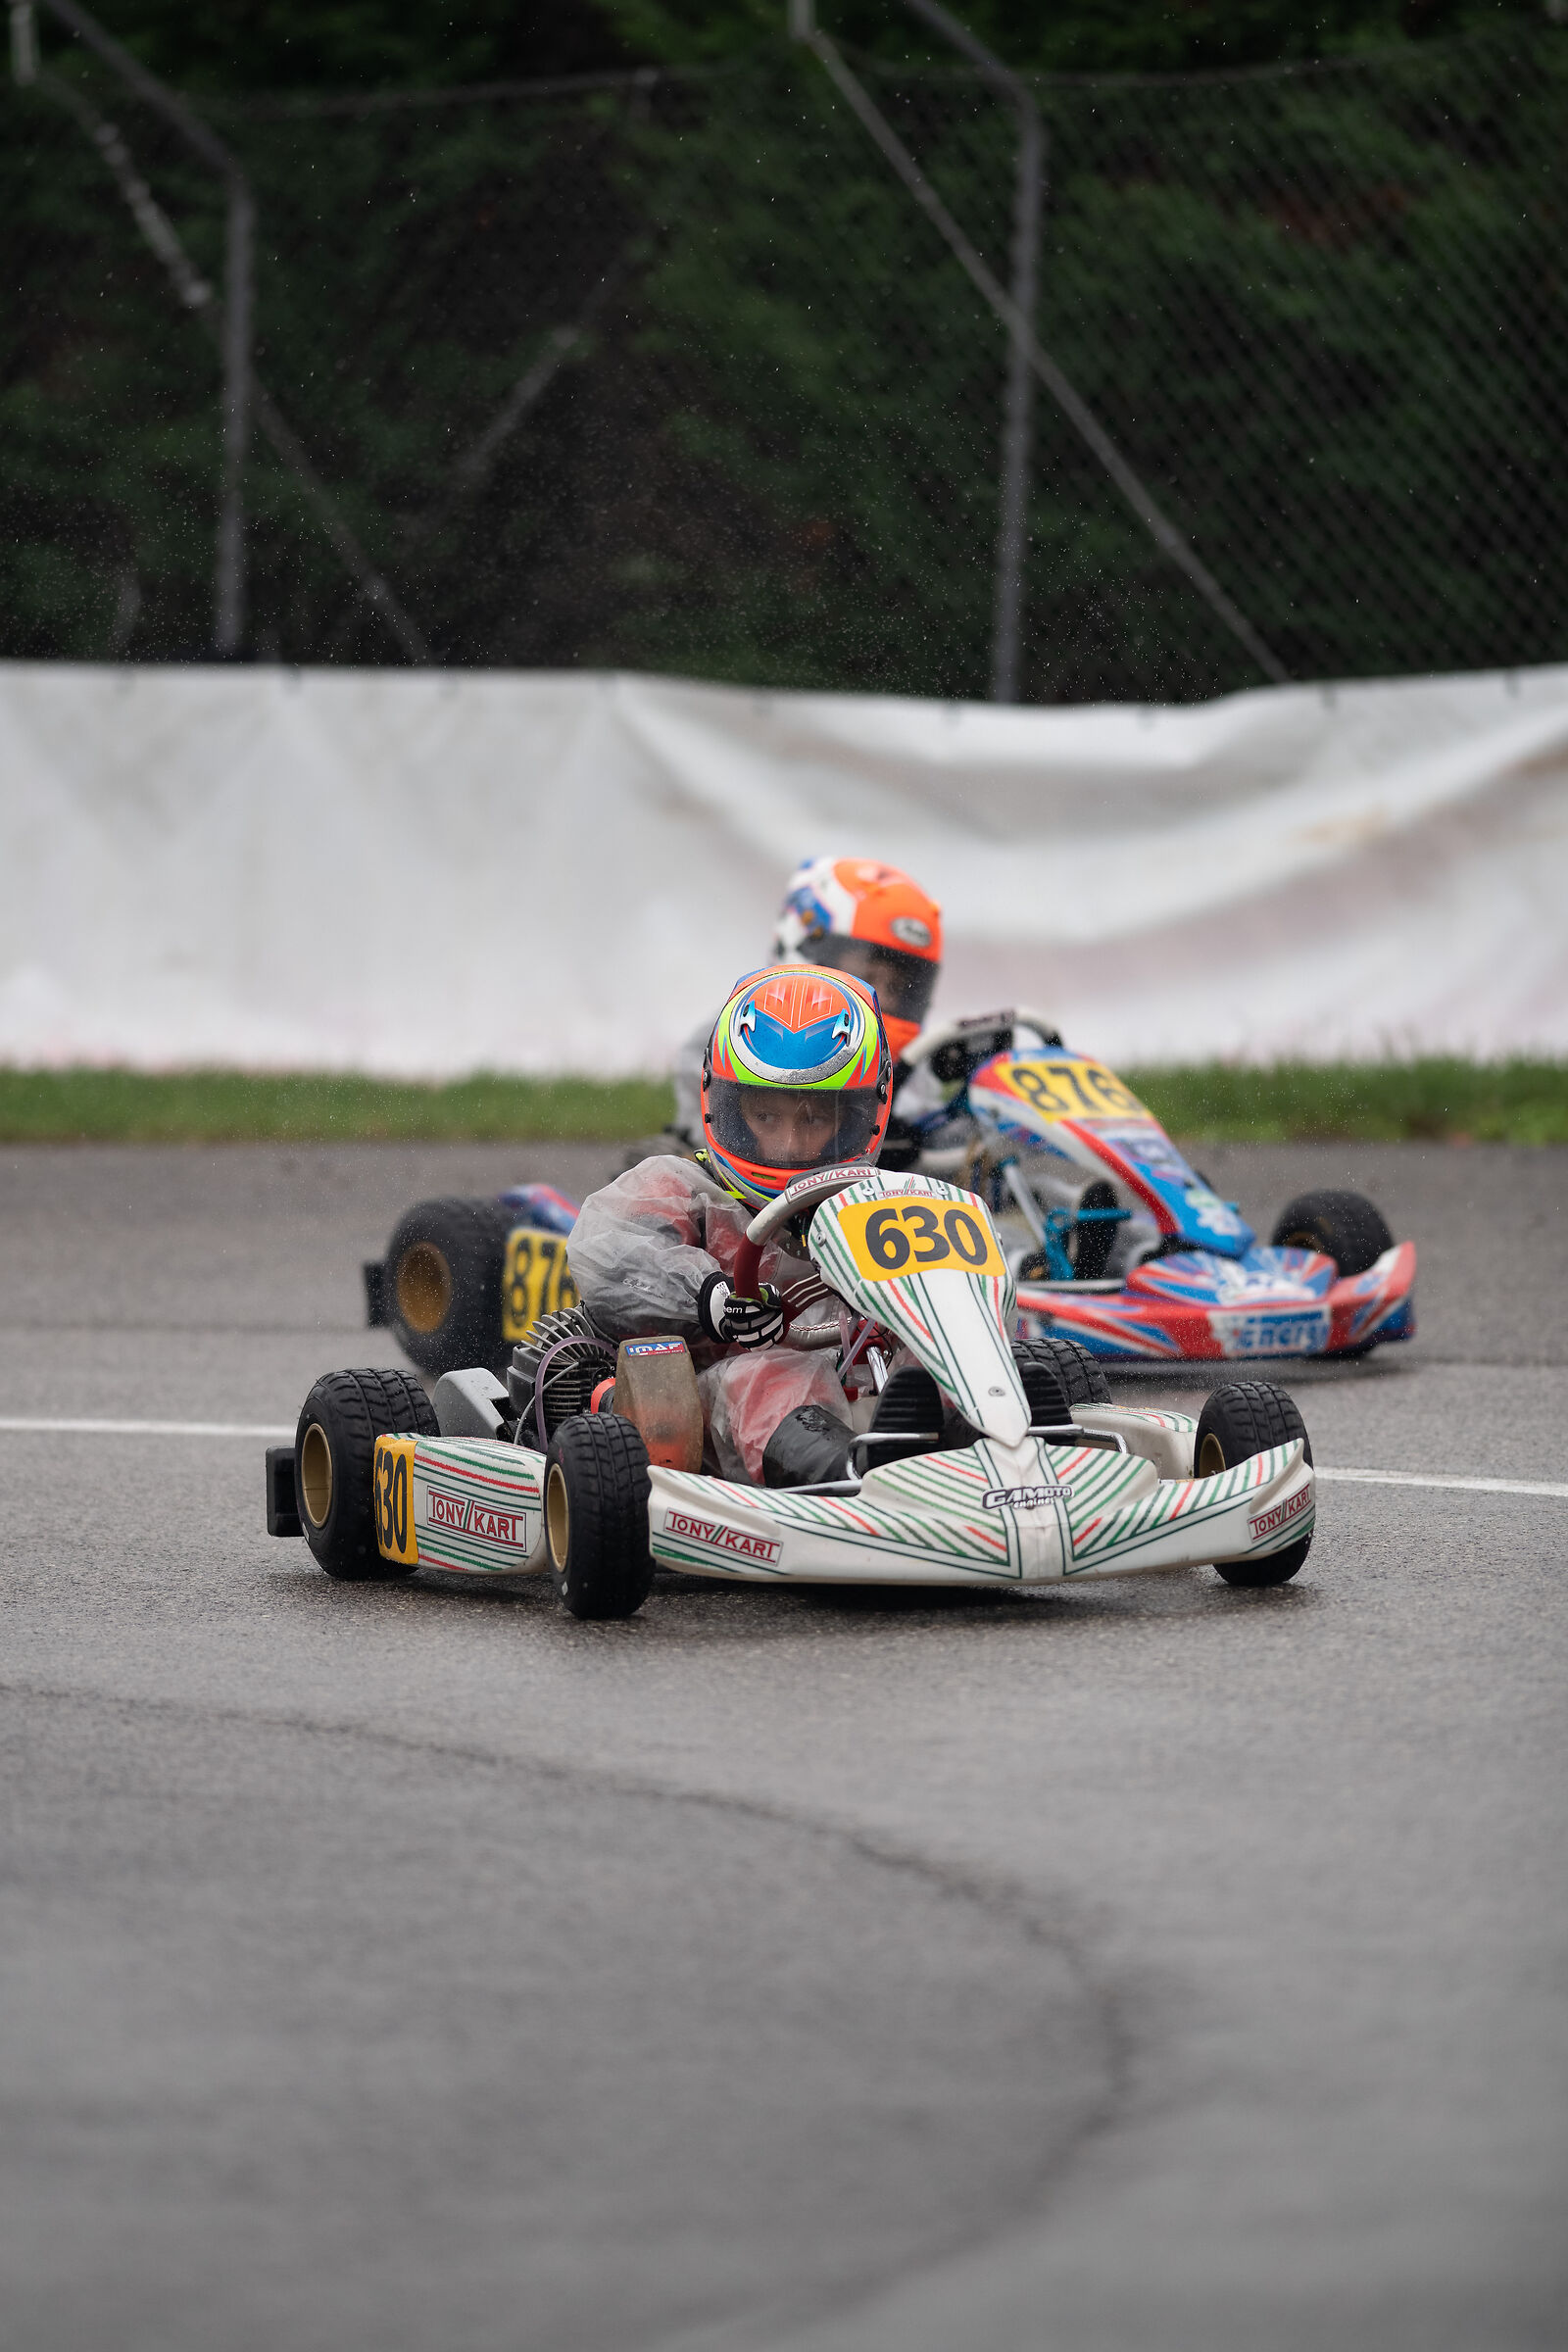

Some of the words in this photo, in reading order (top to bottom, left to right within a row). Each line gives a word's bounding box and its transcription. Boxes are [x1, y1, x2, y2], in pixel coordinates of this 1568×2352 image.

[1011, 1065, 1144, 1112] 876
[865, 1205, 988, 1270] 630
[628, 1343, 682, 1353] IMAF
[374, 1447, 408, 1554] 630
[428, 1490, 466, 1526] TONY
[474, 1504, 524, 1541] KART
[984, 1487, 1072, 1509] GAMOTO
[1250, 1504, 1282, 1536] TONY
[1288, 1484, 1311, 1515] KART
[668, 1510, 716, 1540] TONY
[725, 1529, 781, 1558] KART
